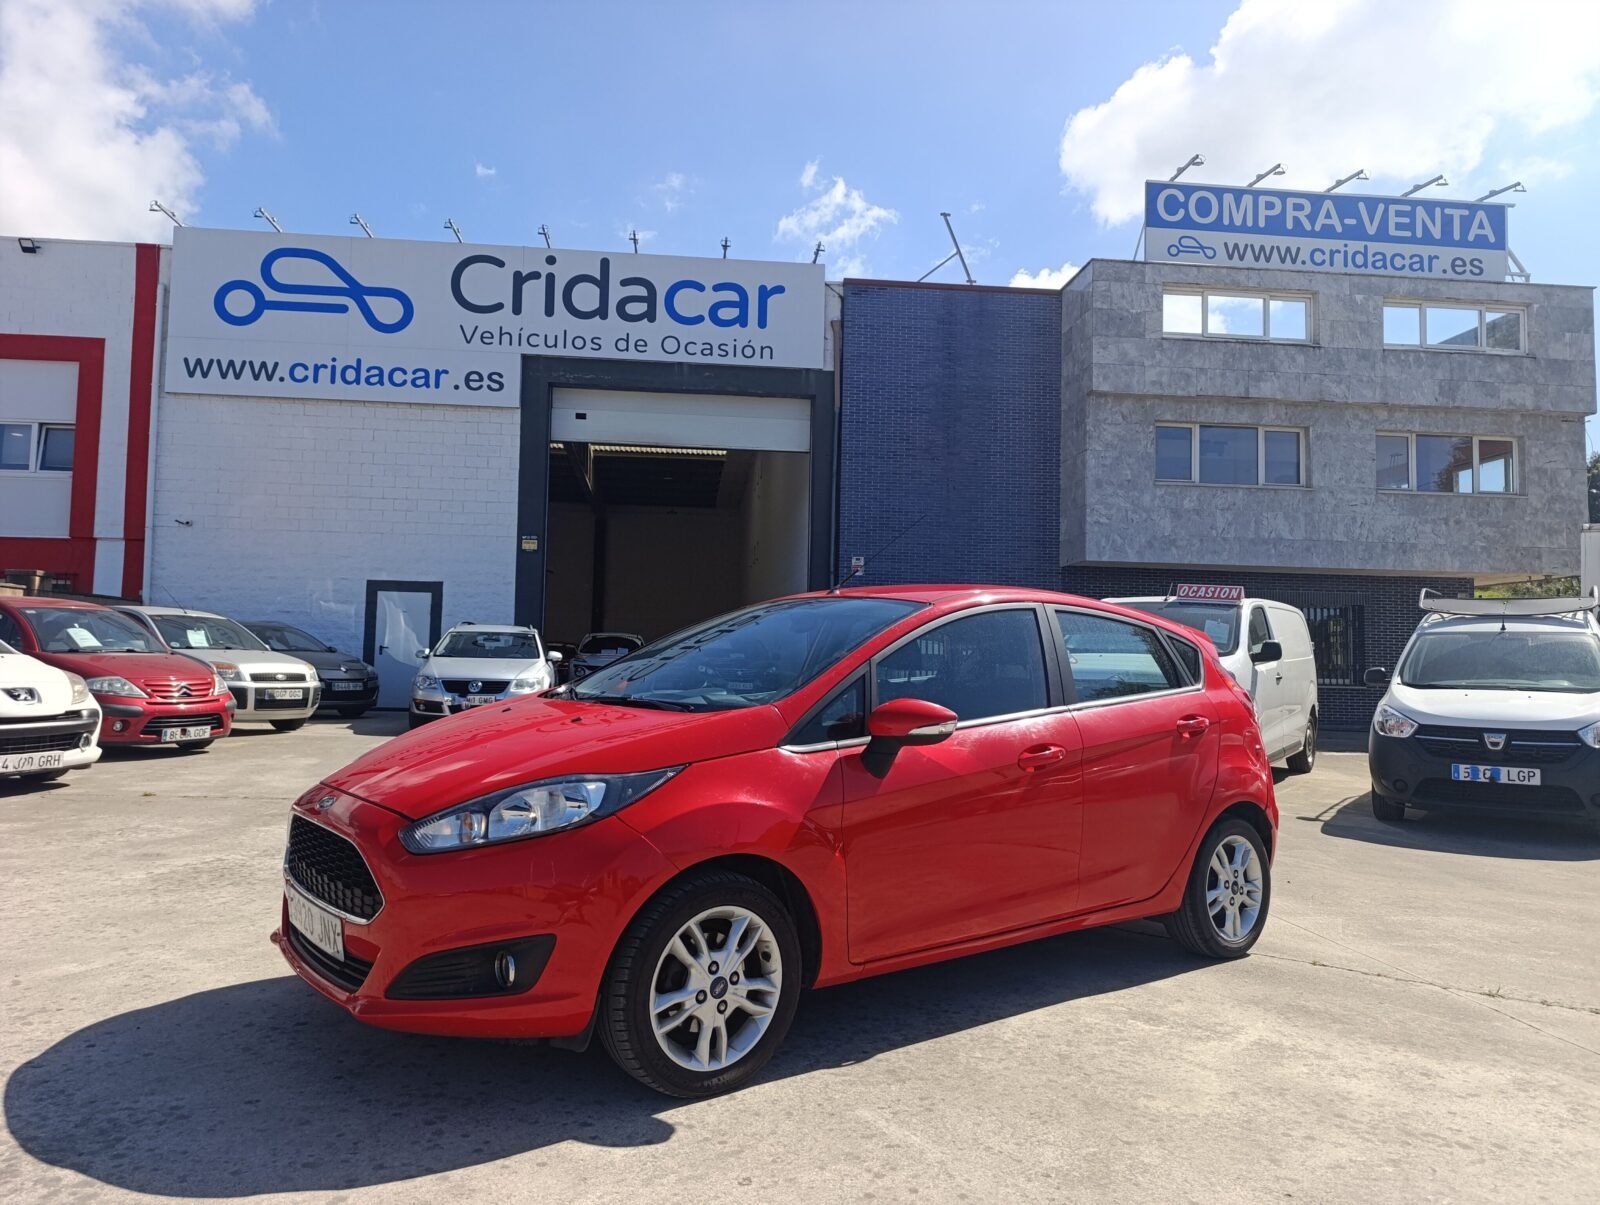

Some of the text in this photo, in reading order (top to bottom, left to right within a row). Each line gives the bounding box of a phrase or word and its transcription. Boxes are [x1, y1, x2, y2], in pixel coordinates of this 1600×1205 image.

[1156, 187, 1496, 244] COMPRA-VENTA
[1223, 241, 1485, 278] www.cridacar.es
[450, 254, 787, 331] Cridacar
[459, 323, 775, 362] Vehículos de Ocasión
[182, 355, 506, 394] www.cridacar.es
[1179, 586, 1240, 598] OCASION
[38, 753, 61, 767] GRH
[1507, 769, 1536, 783] LGP
[318, 913, 340, 954] JNX
